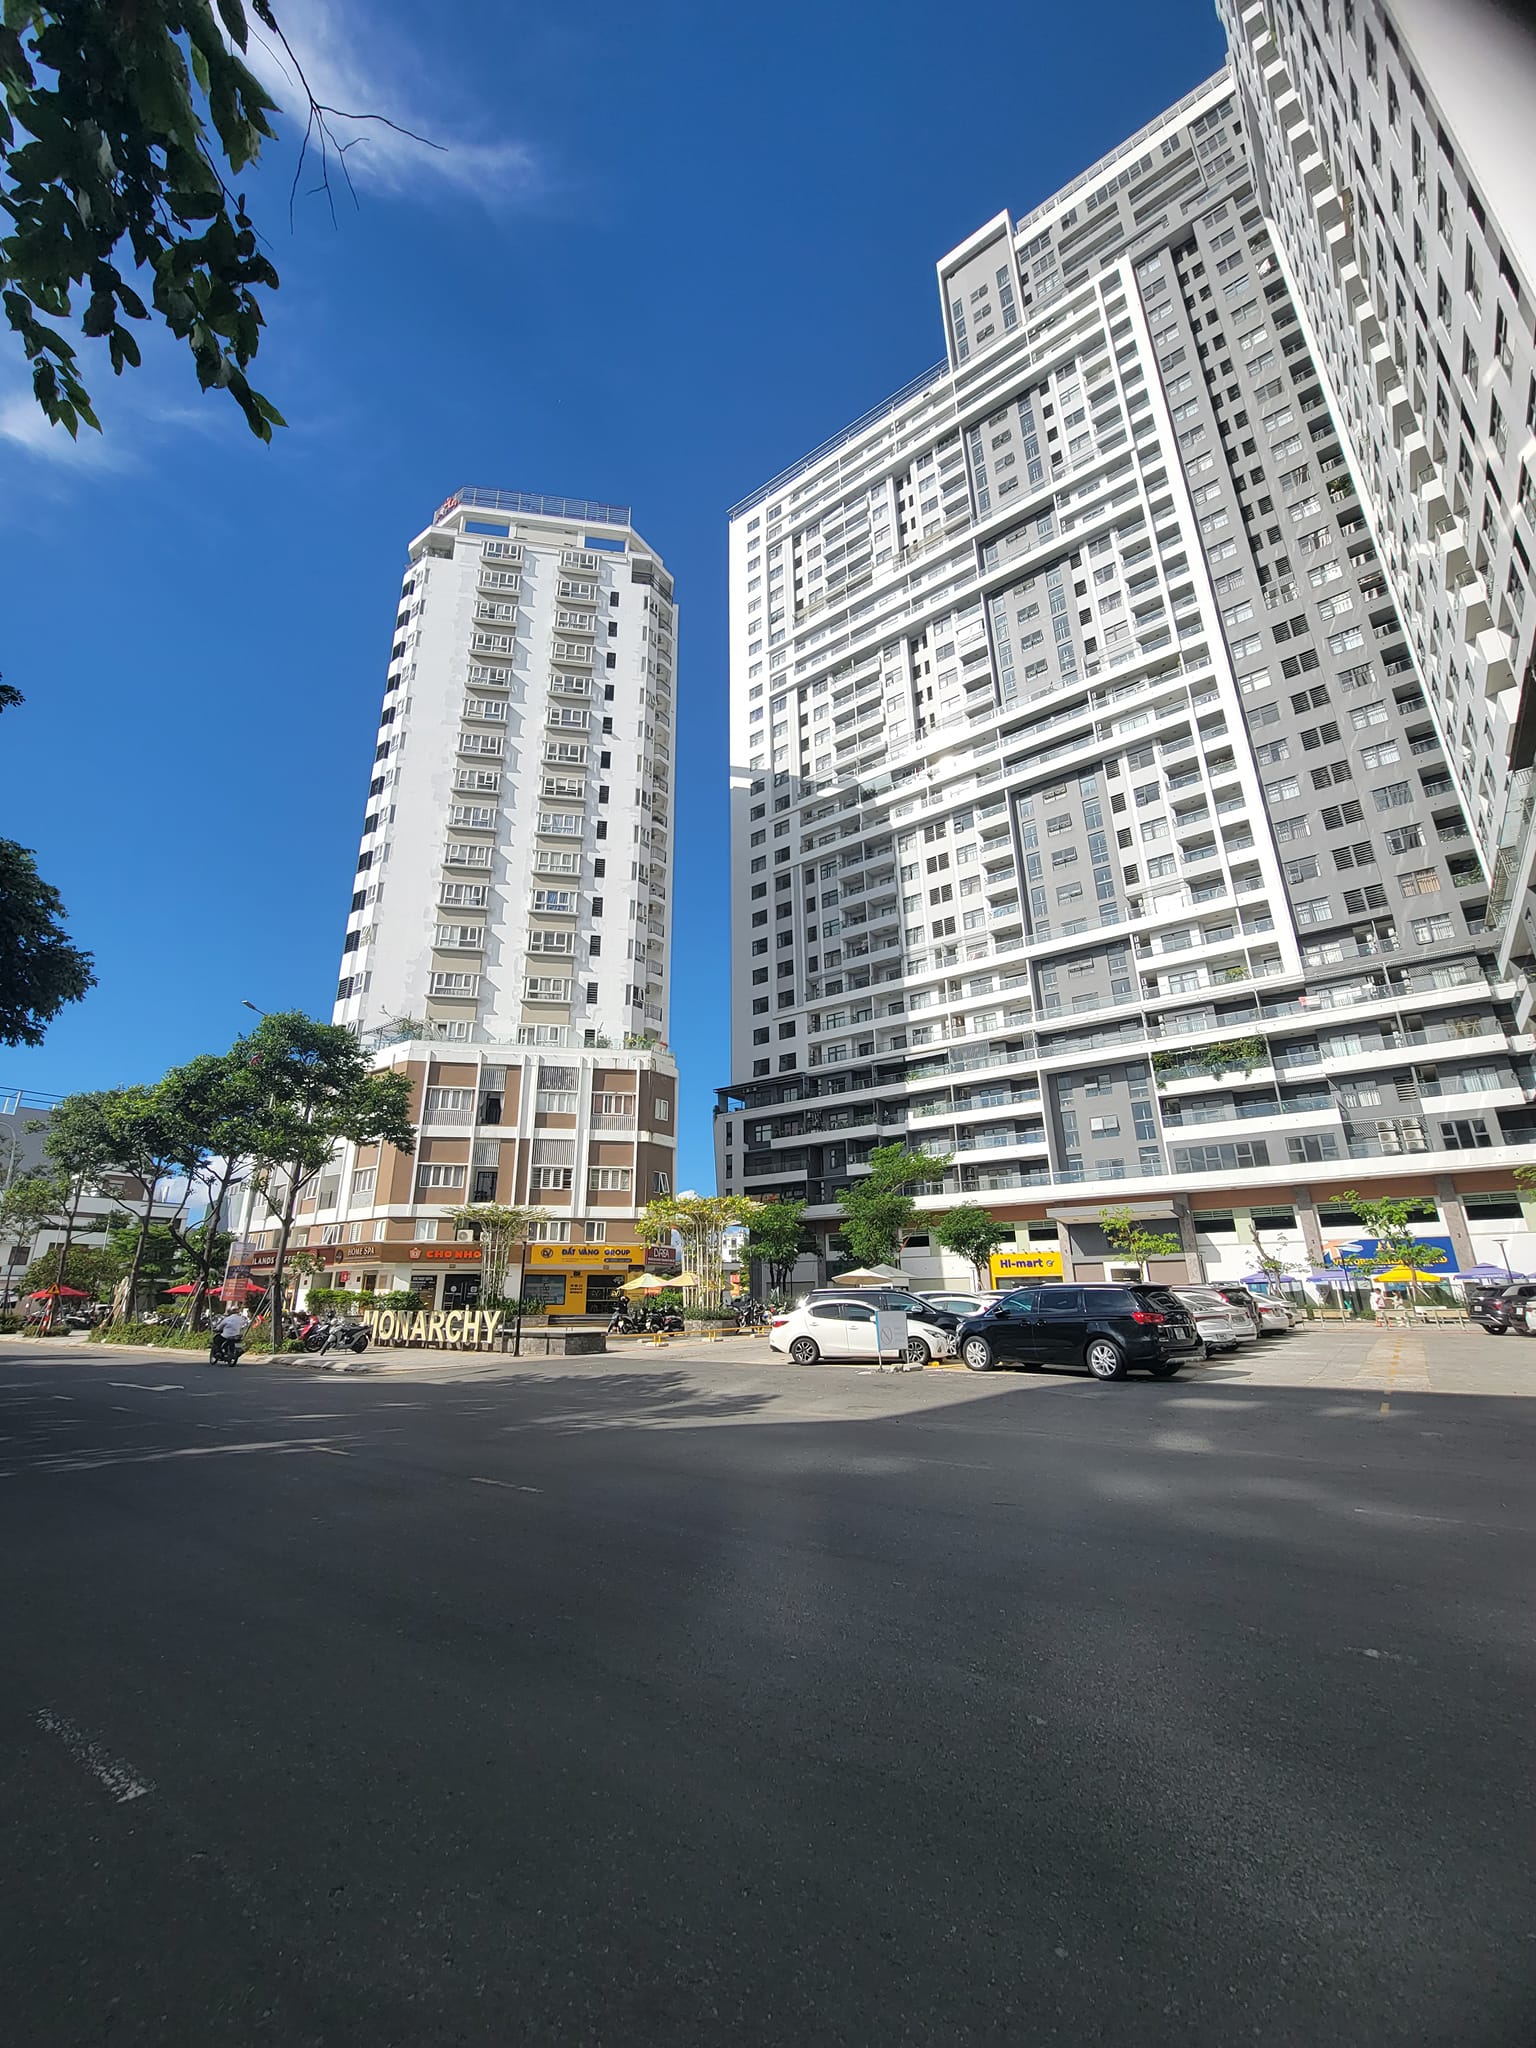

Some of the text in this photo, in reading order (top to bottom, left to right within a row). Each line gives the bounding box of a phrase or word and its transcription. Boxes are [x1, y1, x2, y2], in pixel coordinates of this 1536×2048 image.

[347, 1246, 375, 1256] HOME SPA
[363, 1310, 501, 1344] MONARCHY
